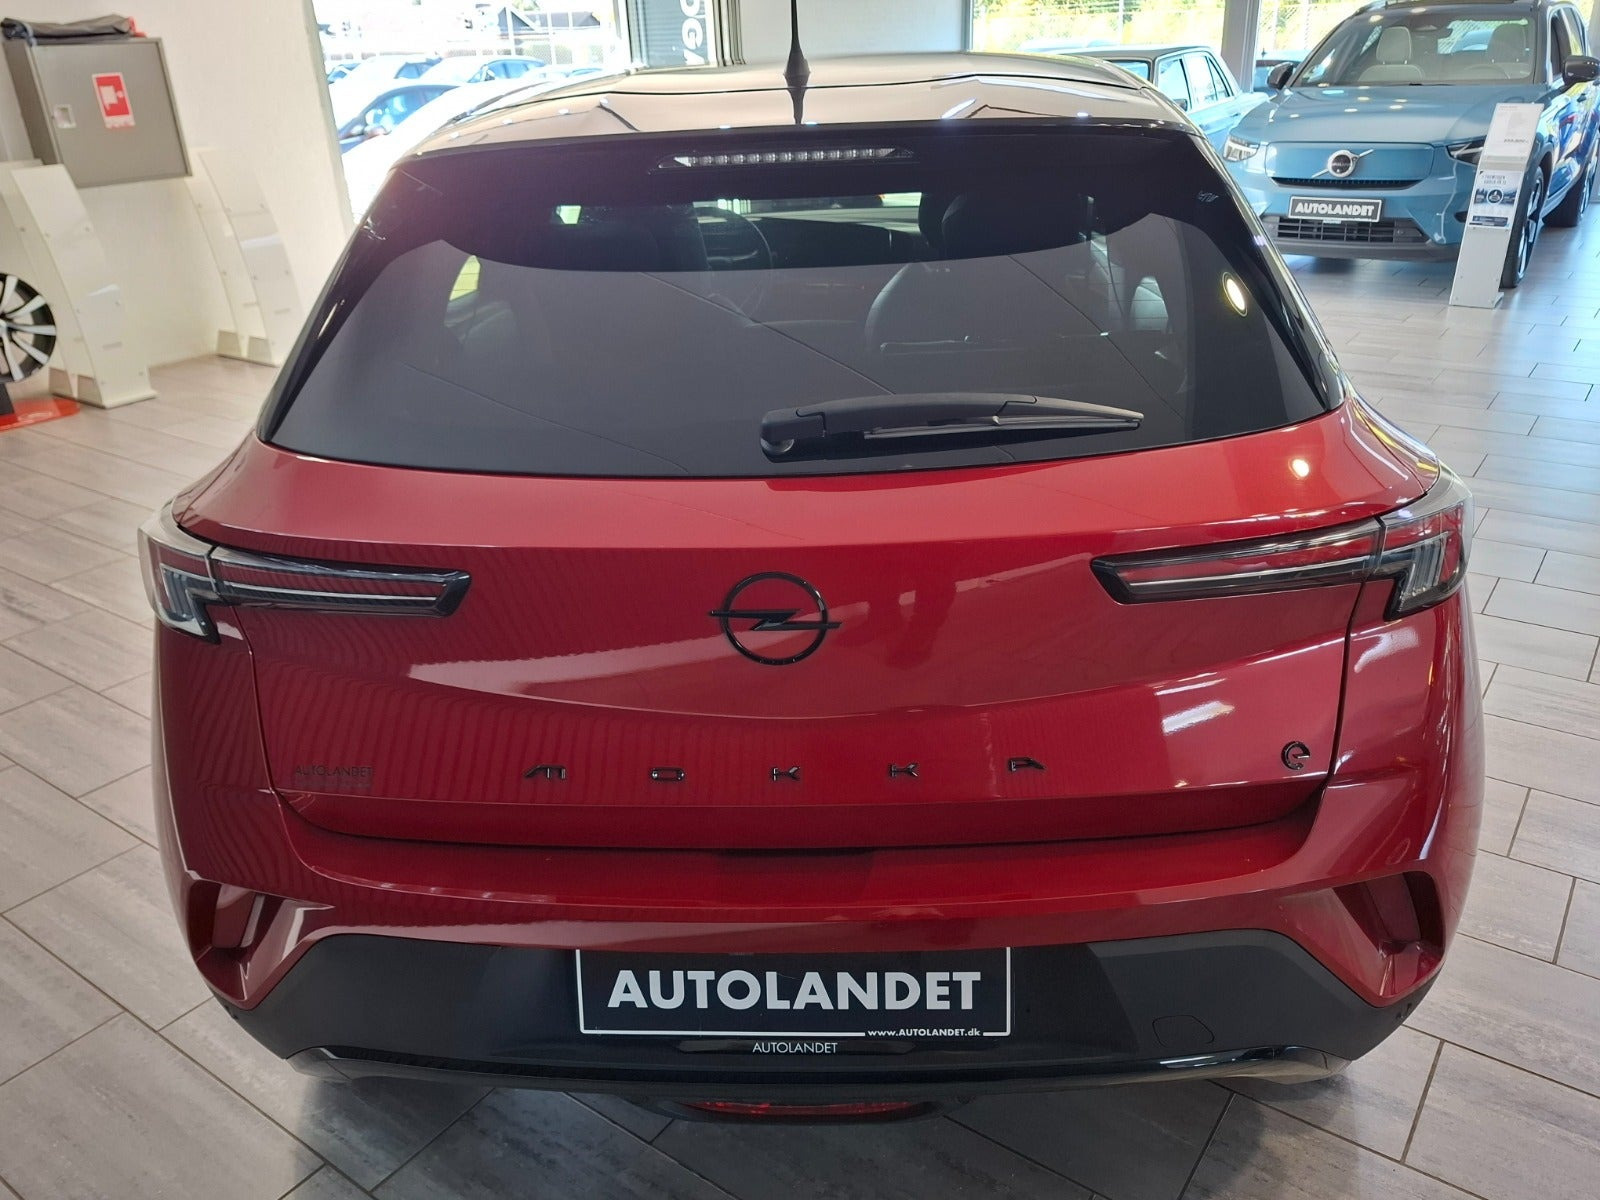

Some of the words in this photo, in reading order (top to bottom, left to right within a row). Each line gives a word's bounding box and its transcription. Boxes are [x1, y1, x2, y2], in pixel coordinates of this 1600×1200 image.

[1294, 202, 1375, 216] AUTOLANDET
[295, 765, 373, 777] AUTOLANDET
[525, 757, 1045, 782] MOKKA
[607, 969, 981, 1010] AUTOLANDET
[867, 1027, 981, 1037] www.AUTOLANDET.dk
[752, 1041, 838, 1053] AUTOLANDET
